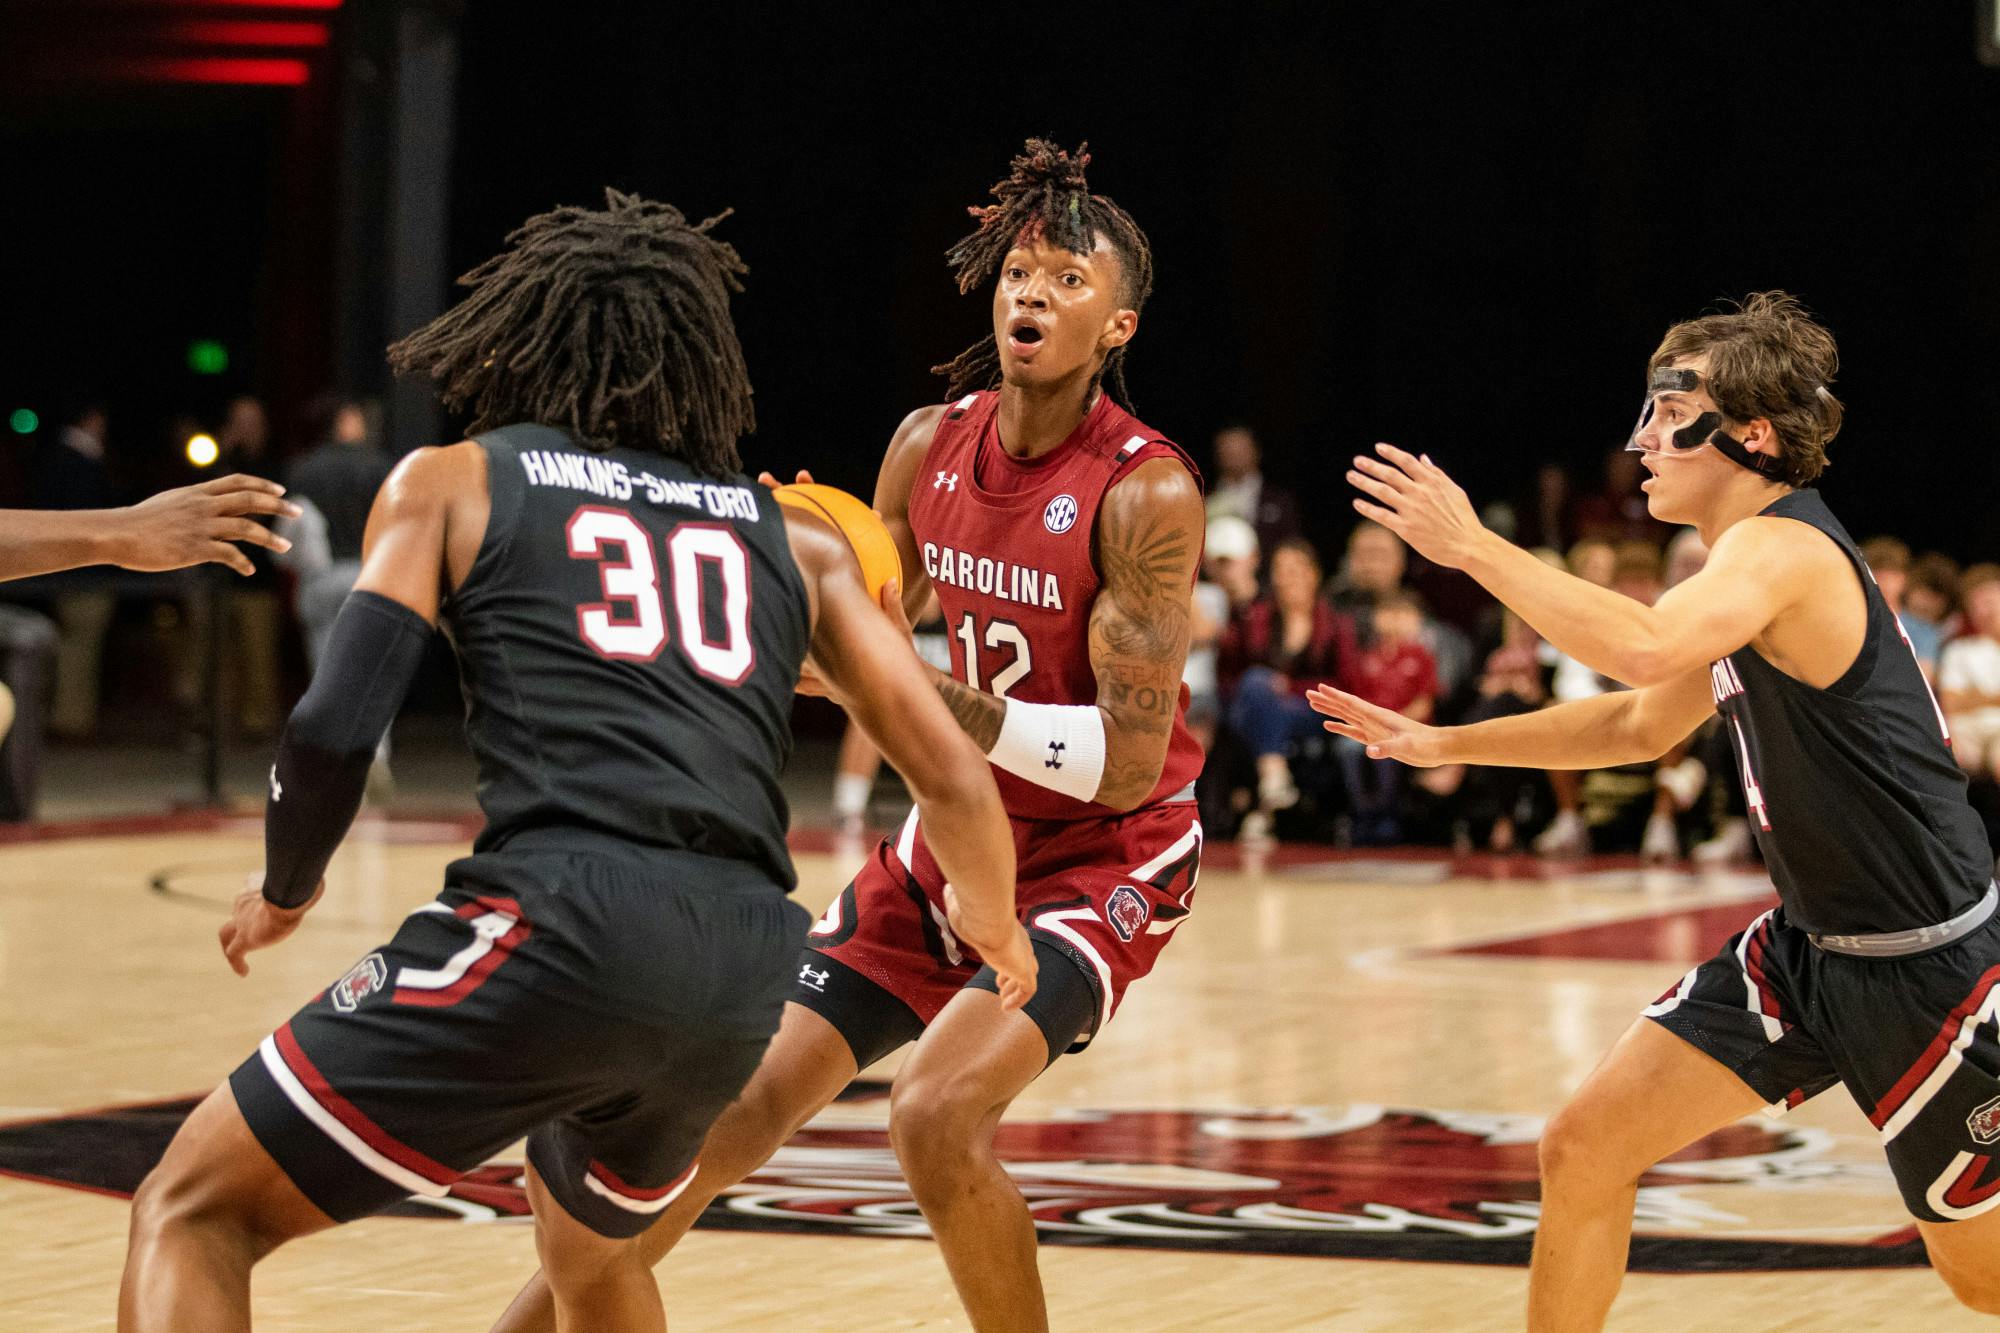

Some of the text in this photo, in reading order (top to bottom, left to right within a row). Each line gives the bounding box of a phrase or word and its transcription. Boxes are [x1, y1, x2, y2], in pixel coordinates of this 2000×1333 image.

[520, 450, 760, 523] HANKINS-SANFORD
[1045, 496, 1076, 532] SEC
[565, 504, 757, 687] 30
[923, 541, 1064, 611] CAROLINA
[956, 611, 1032, 698] 12
